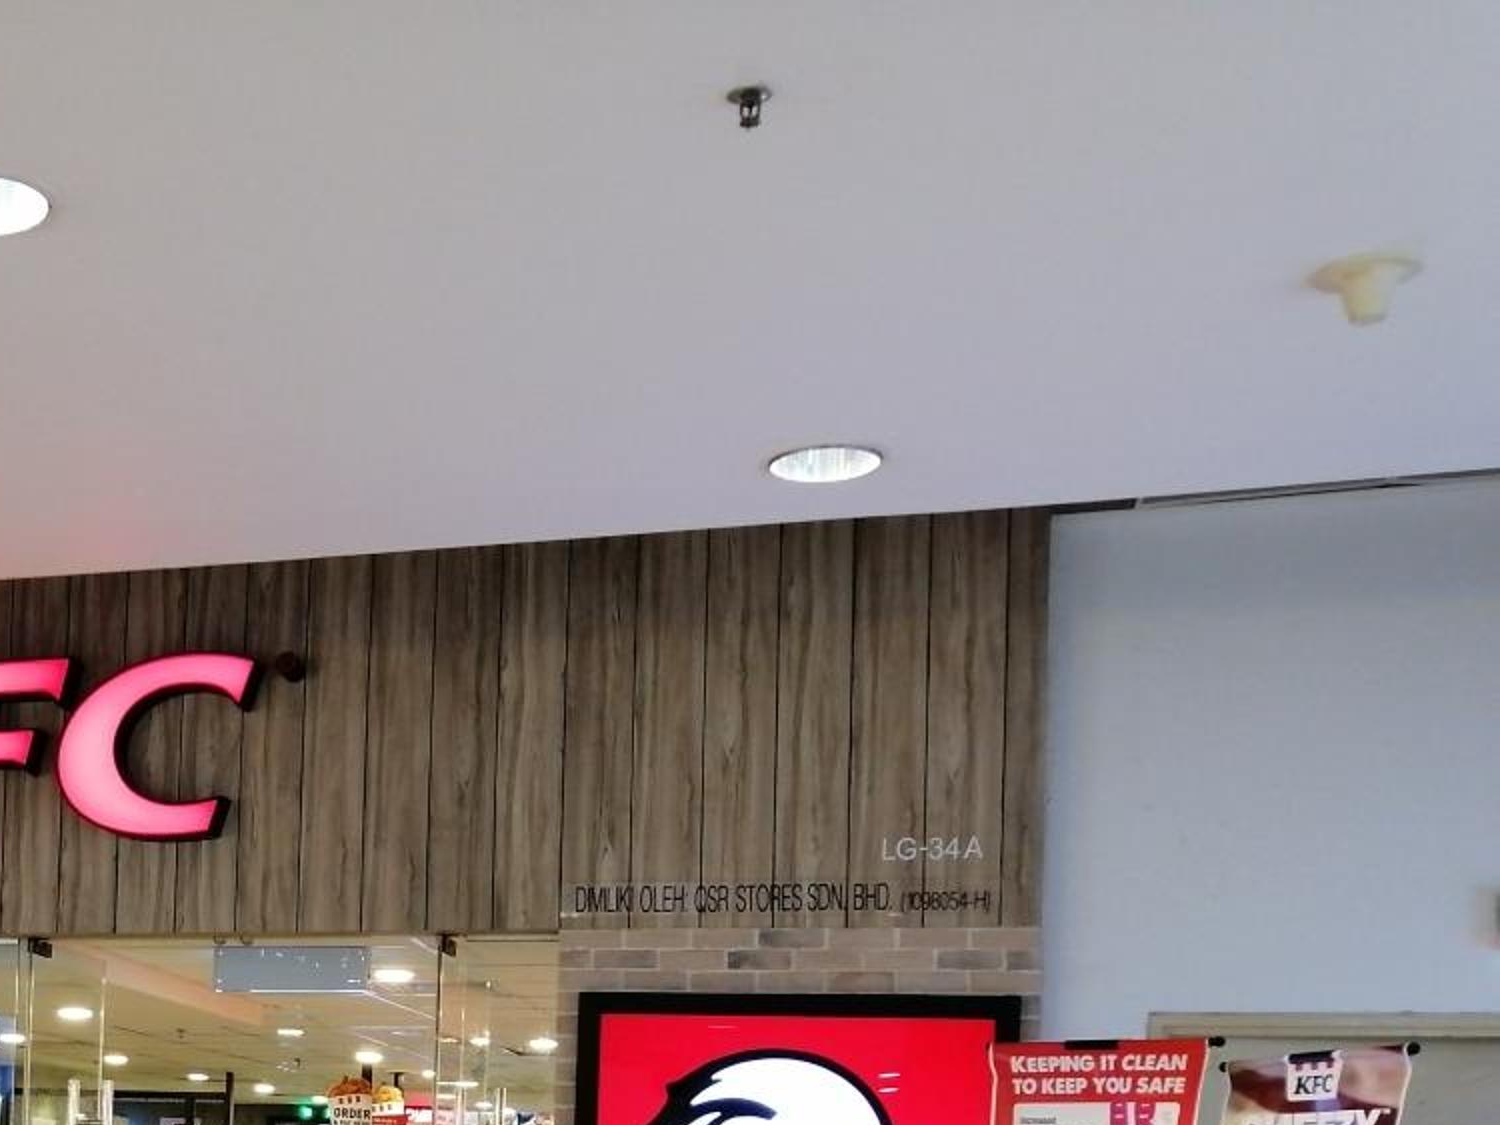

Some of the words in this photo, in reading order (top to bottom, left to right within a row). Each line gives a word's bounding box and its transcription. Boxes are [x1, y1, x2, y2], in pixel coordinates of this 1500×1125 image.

[882, 836, 984, 861] LG-34A
[694, 885, 729, 914] QSR
[735, 883, 803, 913] STORES
[853, 883, 894, 912] BHD.
[1010, 1054, 1095, 1074] KEEPING
[1100, 1054, 1117, 1072] IT
[1121, 1053, 1189, 1071] CLEAN
[1012, 1078, 1037, 1095] TO
[1041, 1078, 1088, 1095] KEEP
[1092, 1077, 1131, 1094] YOU
[1136, 1077, 1187, 1094] SAFE
[1294, 1074, 1334, 1095] KFC
[333, 1106, 371, 1120] ORDER
